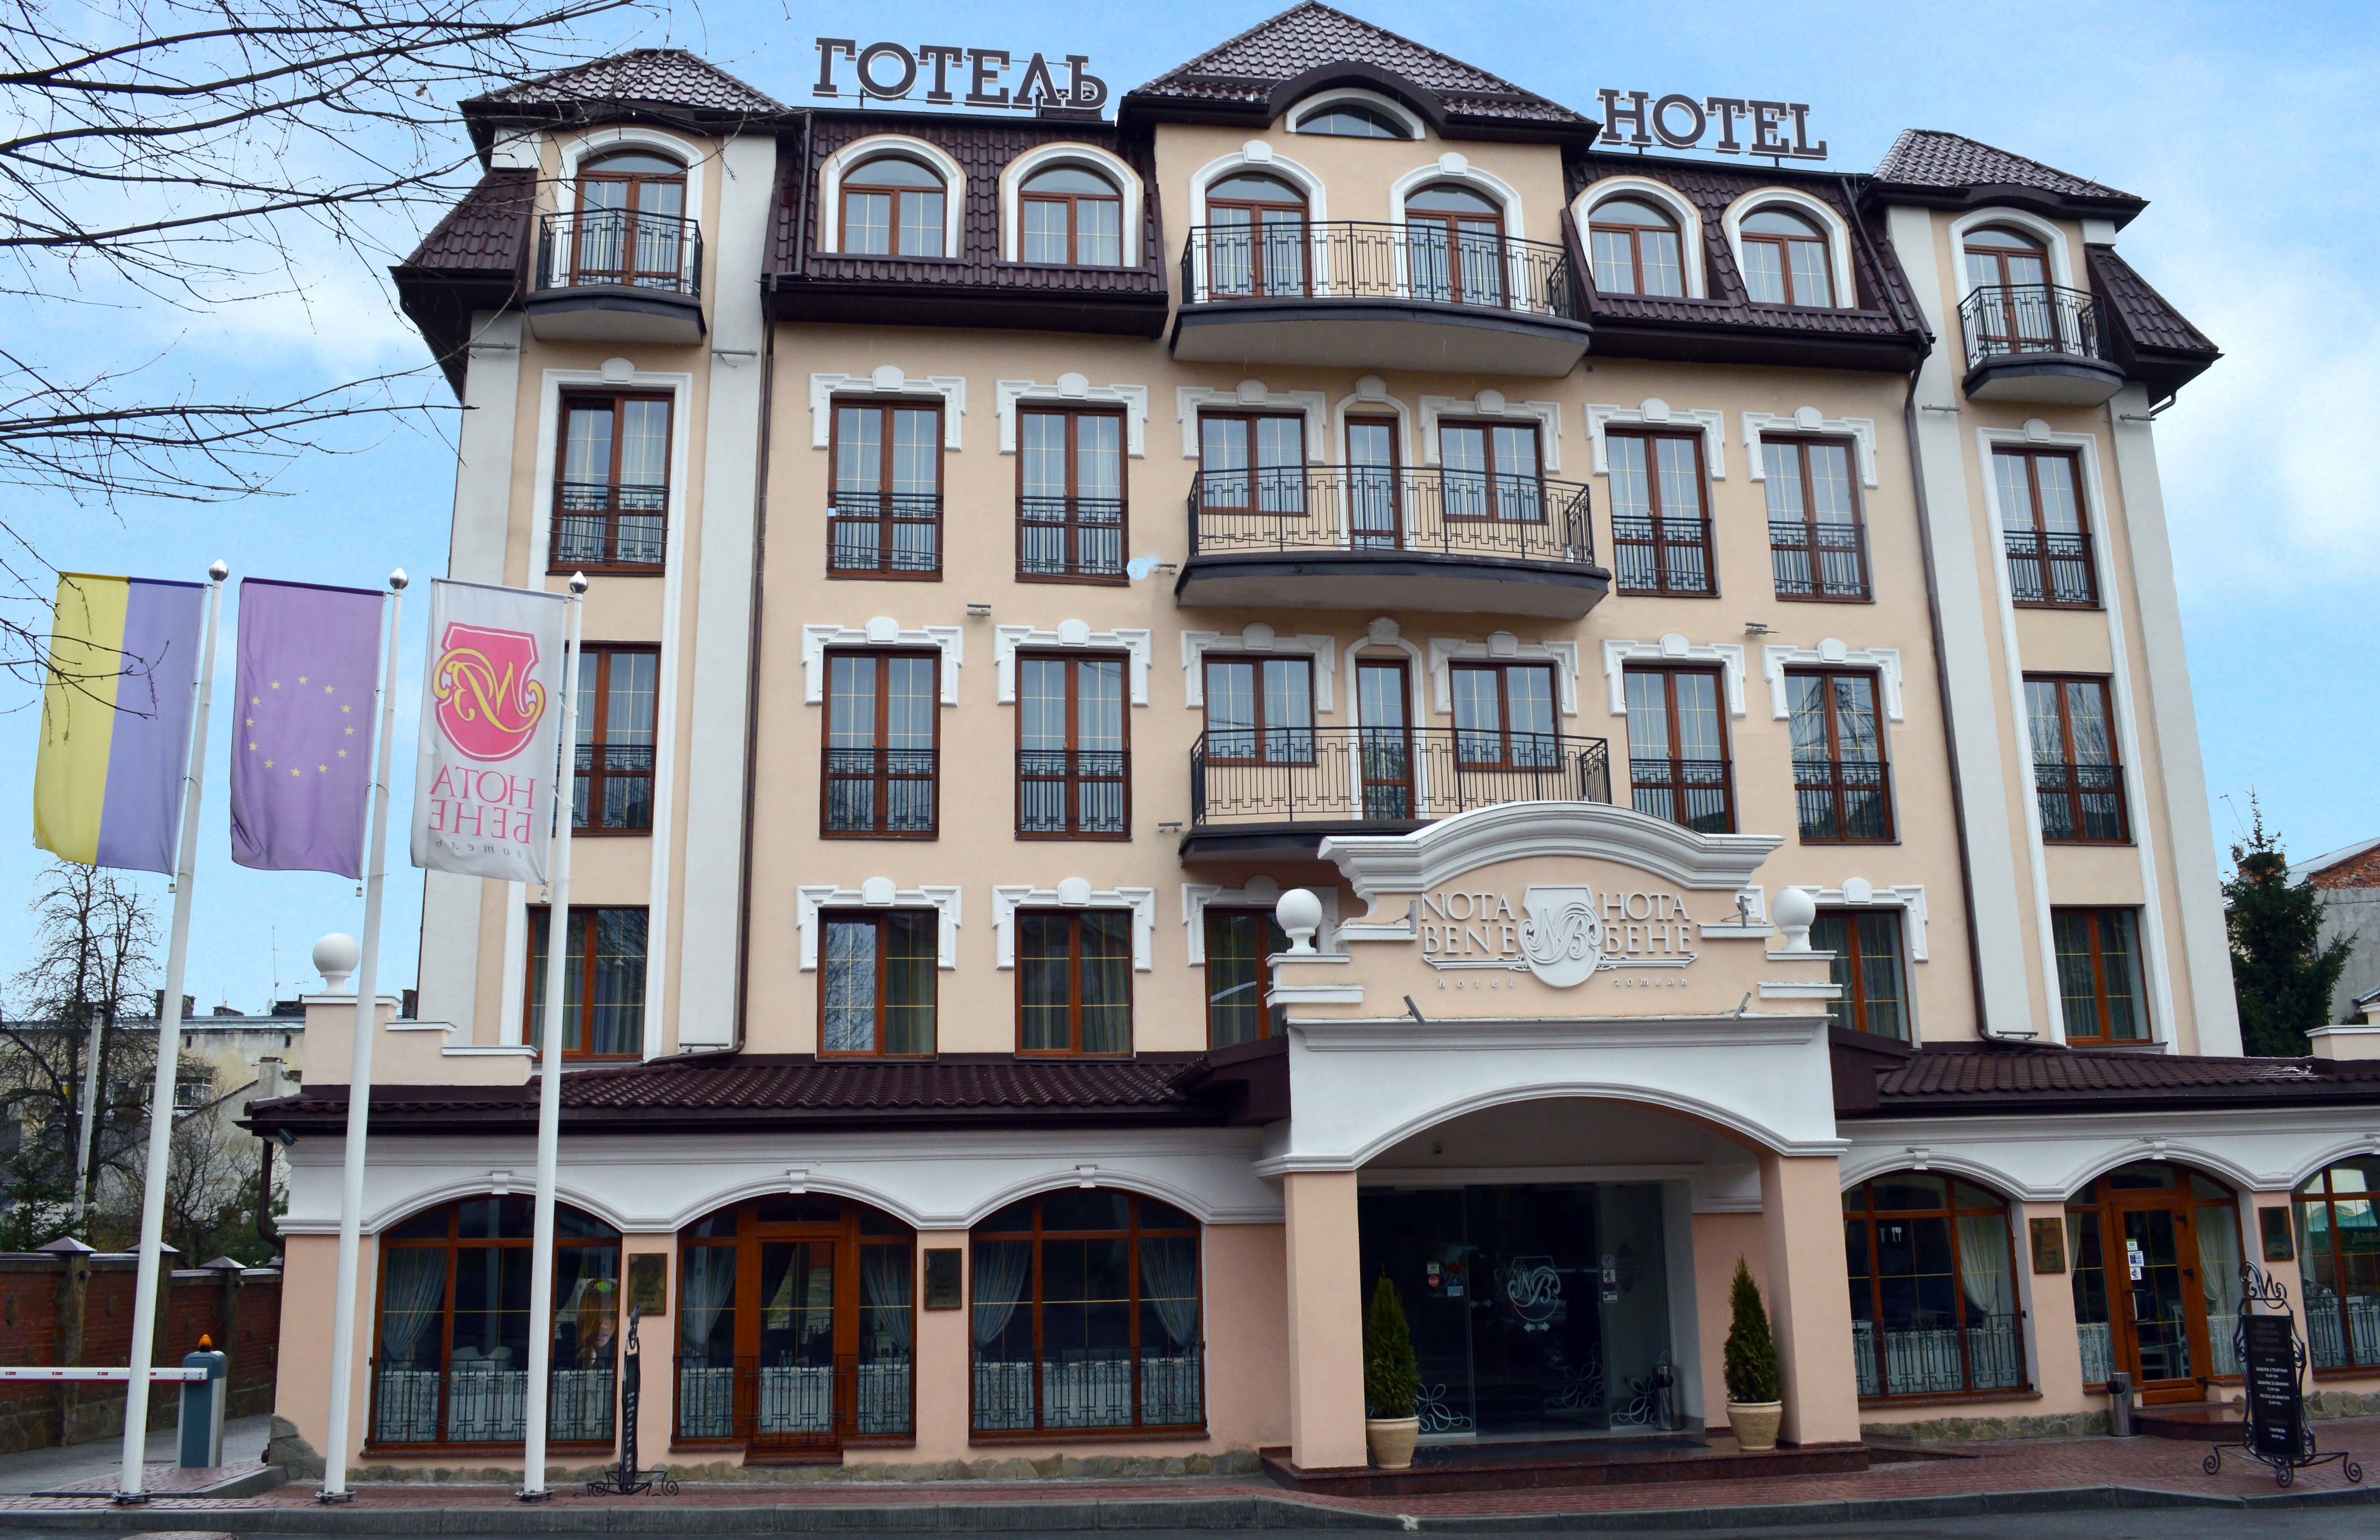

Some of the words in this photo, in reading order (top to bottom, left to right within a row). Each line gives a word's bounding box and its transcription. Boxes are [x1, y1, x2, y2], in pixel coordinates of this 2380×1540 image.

[813, 37, 1108, 110] ГОТЕЛЬ
[1597, 89, 1828, 161] HOTEL
[1421, 892, 1516, 921] NOTA
[1600, 892, 1691, 921] НОТА
[1422, 926, 1517, 954] BENE
[1602, 925, 1692, 953] БЕНЕ
[1439, 977, 1514, 988] hotel
[1615, 977, 1688, 987] готель
